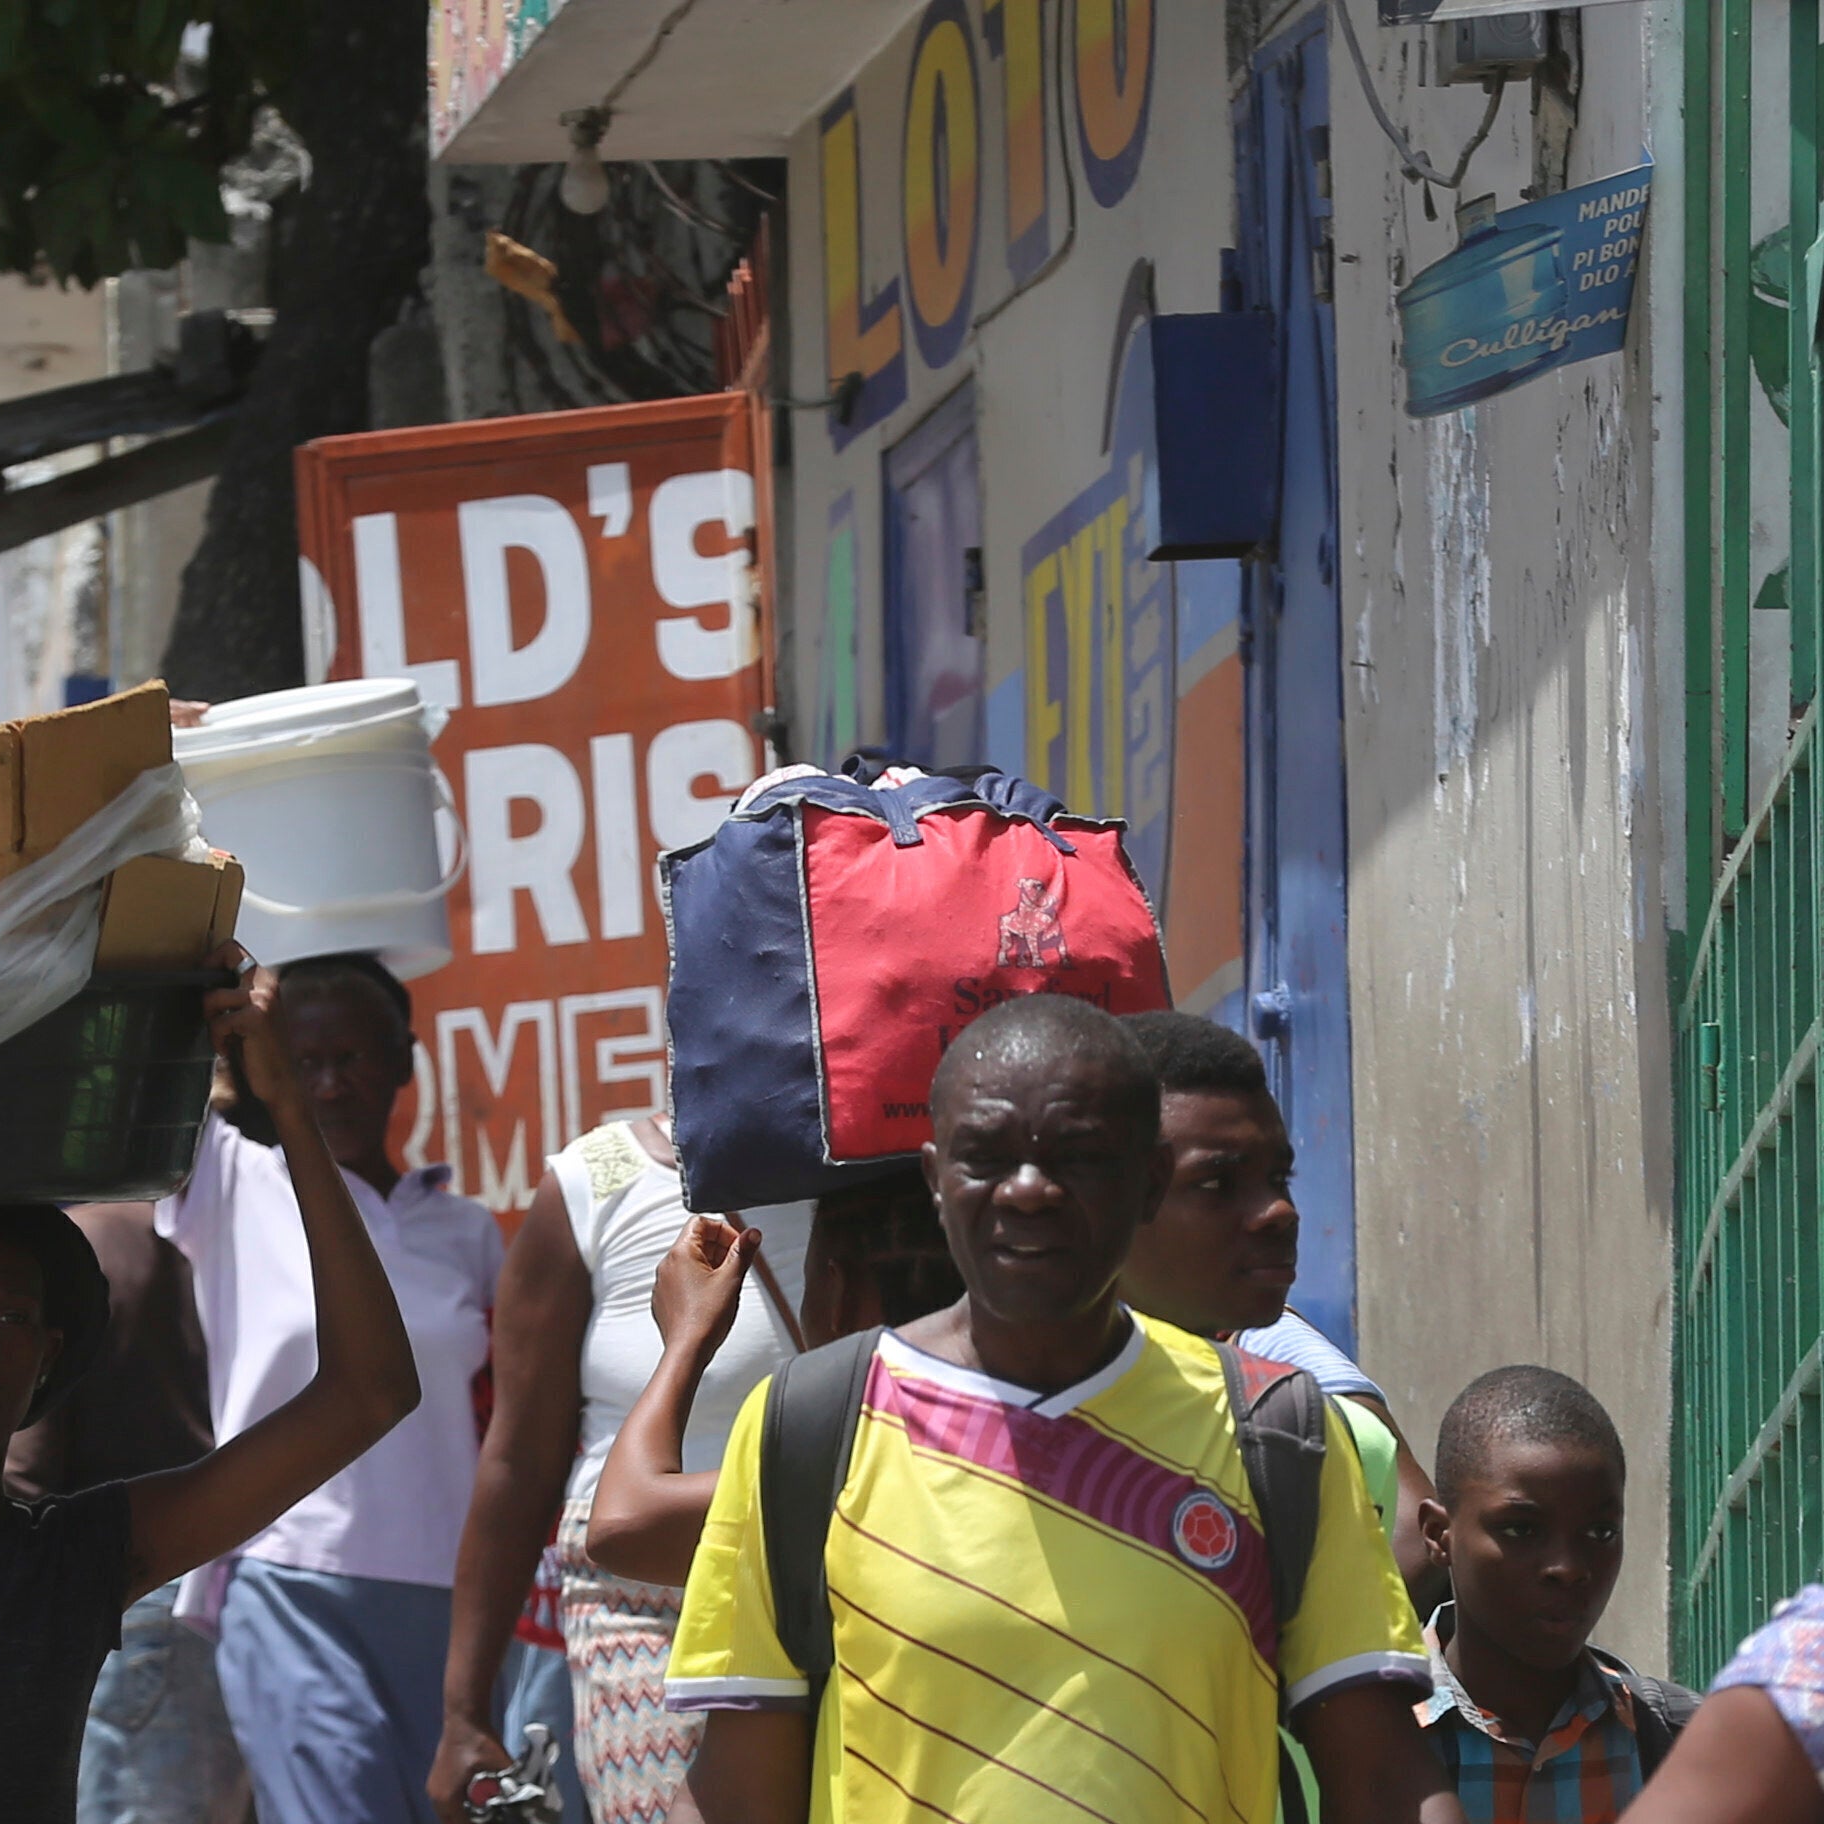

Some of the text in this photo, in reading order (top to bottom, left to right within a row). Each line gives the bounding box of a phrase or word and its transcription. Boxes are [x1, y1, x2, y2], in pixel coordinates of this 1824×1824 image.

[1573, 248, 1595, 271] PI
[1579, 264, 1620, 292] DLO
[1439, 306, 1628, 369] Culligan
